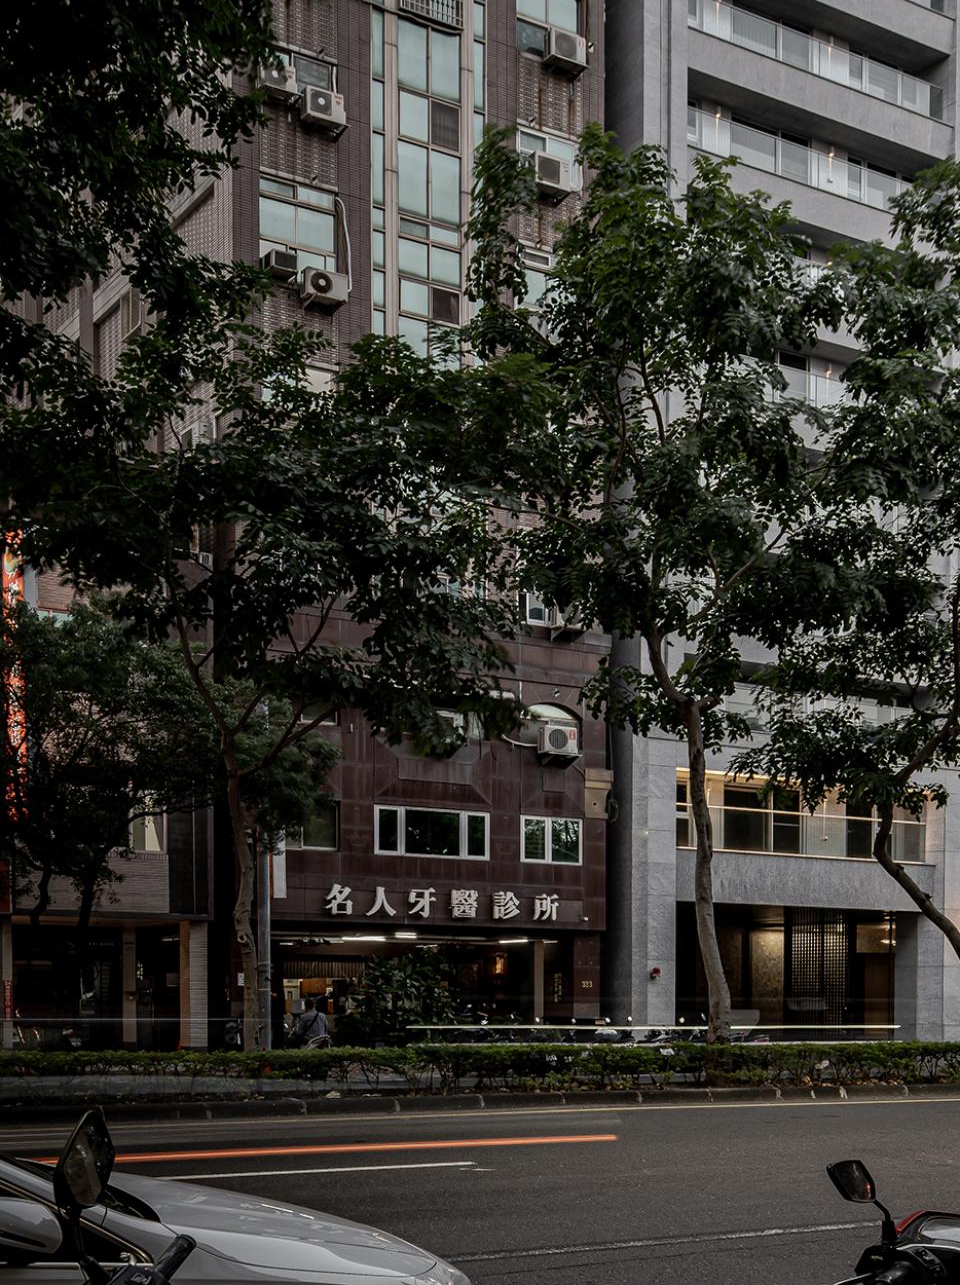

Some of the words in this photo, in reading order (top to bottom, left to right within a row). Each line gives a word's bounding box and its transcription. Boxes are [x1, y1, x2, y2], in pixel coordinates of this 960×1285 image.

[325, 883, 559, 921] 名人牙醫診所
